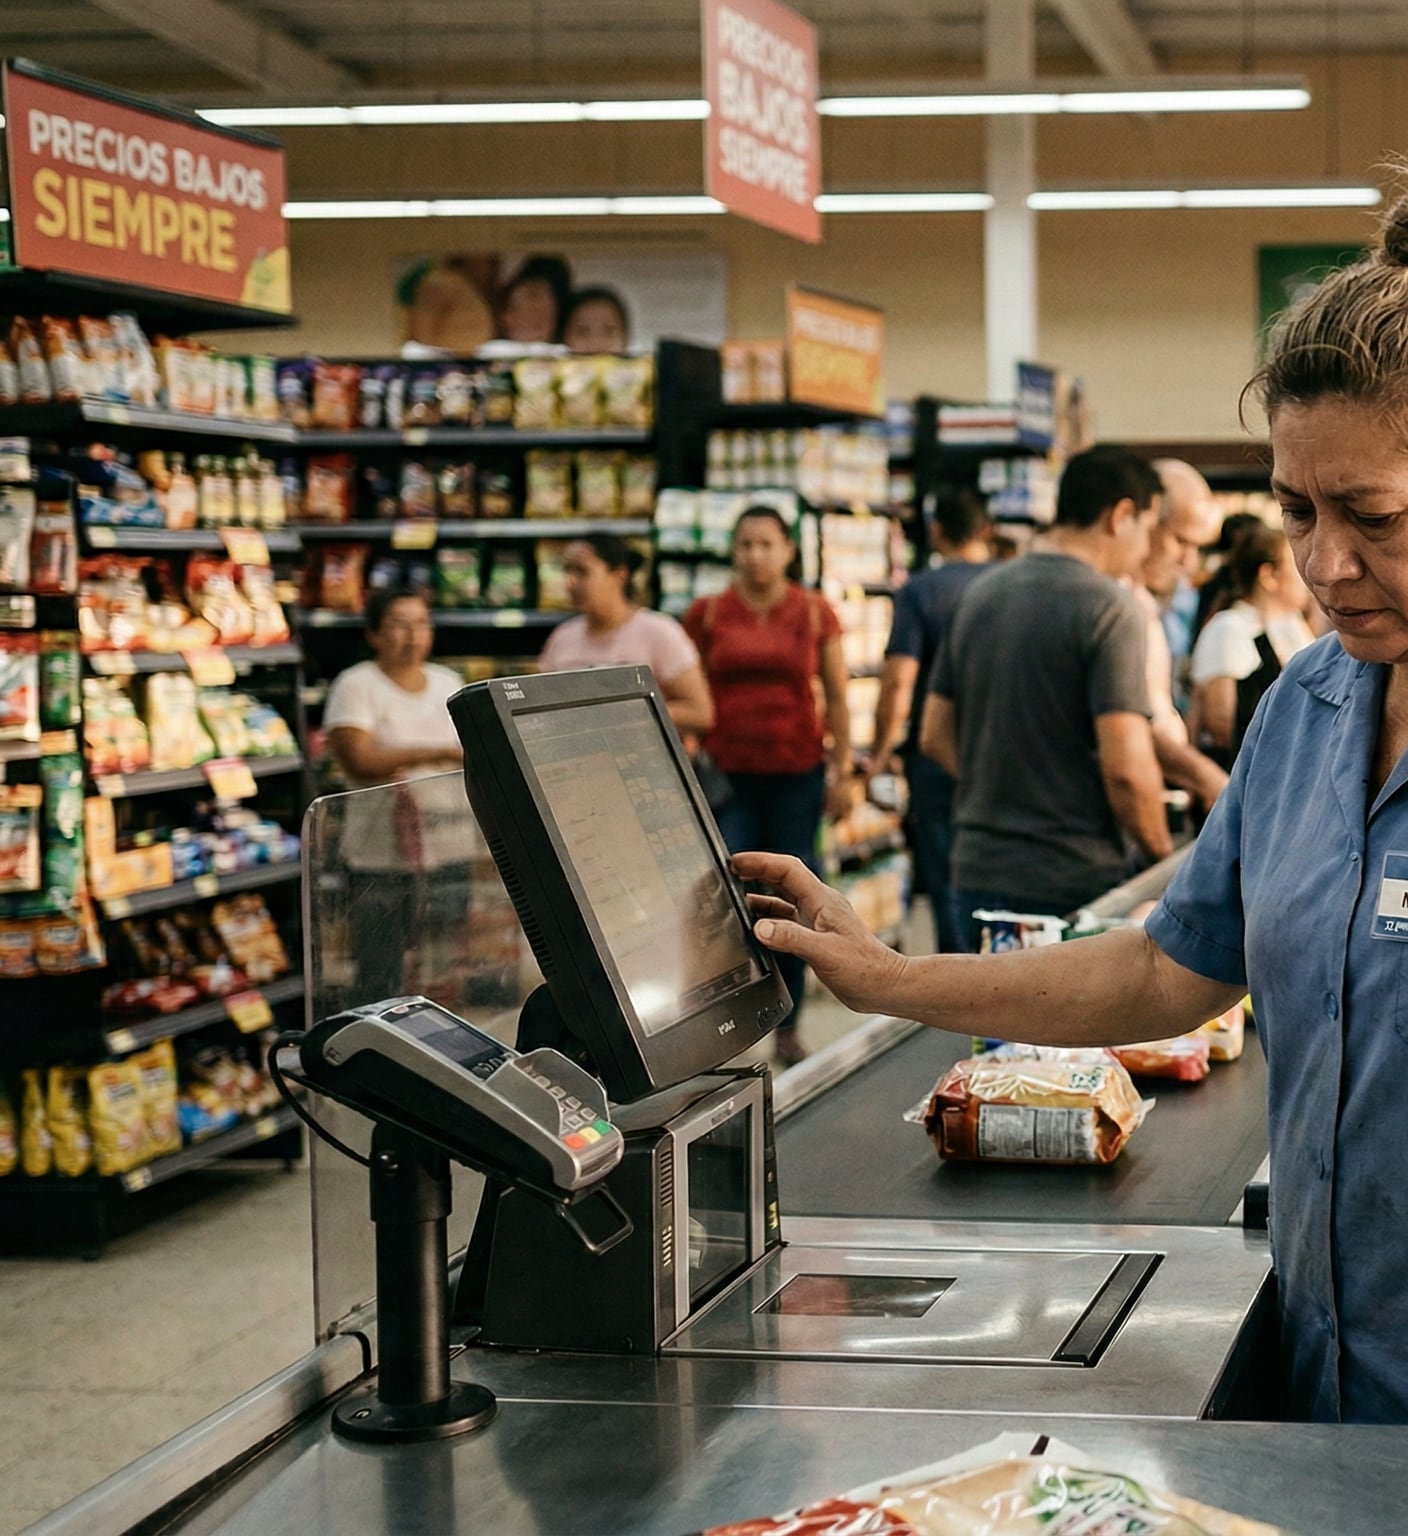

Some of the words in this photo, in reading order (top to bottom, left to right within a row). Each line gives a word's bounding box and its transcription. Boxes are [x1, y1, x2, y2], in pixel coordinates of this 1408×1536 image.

[718, 6, 808, 93] PRECIOS
[718, 58, 809, 151] BAJOS
[28, 108, 169, 186] PRECIOS
[173, 147, 268, 211] BAJOS
[33, 167, 239, 273] SIEMPRE
